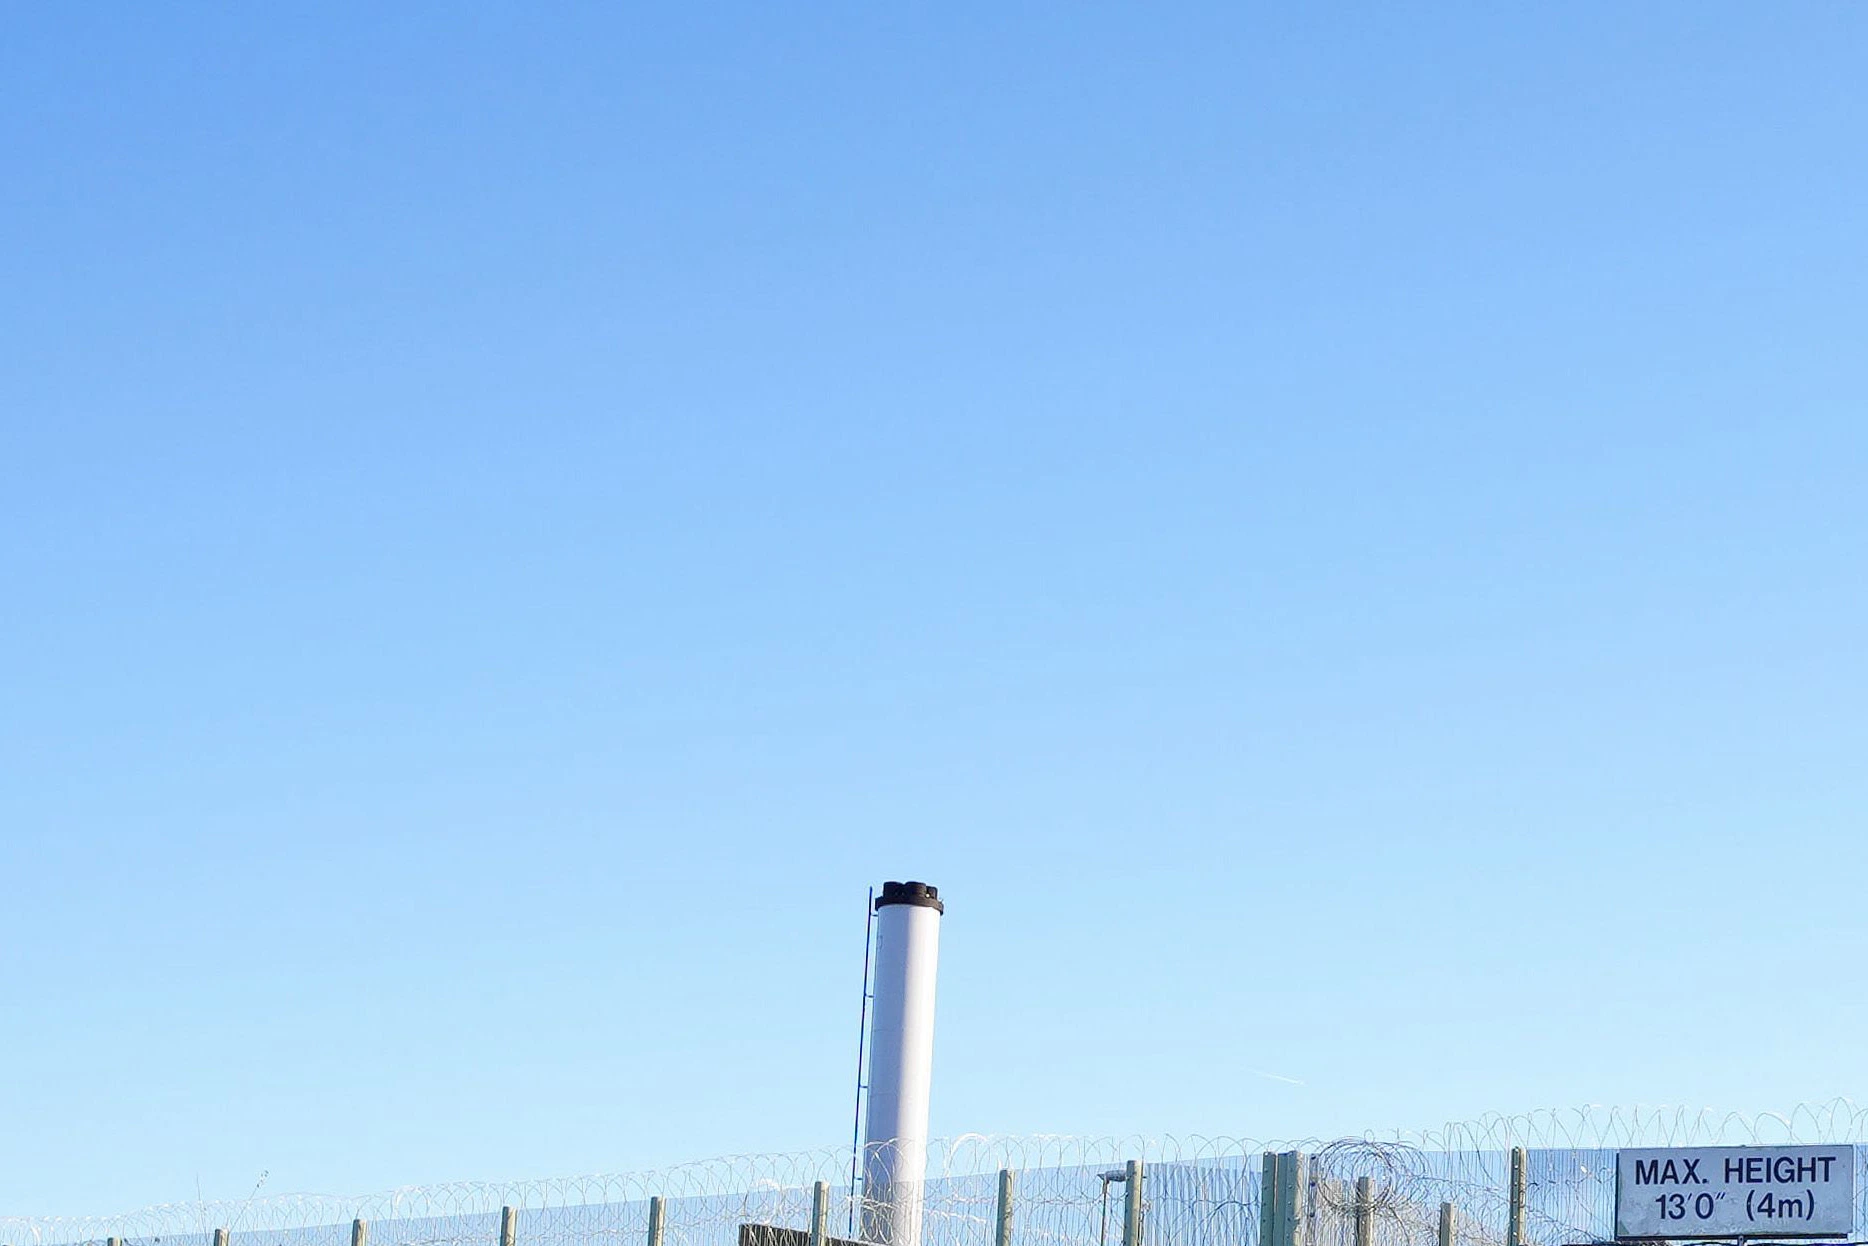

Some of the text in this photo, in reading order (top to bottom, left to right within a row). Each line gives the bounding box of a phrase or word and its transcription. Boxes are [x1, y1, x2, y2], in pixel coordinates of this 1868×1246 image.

[1634, 1156, 1837, 1185] MAX. HEIGHT
[1745, 1188, 1815, 1222] (4m)
